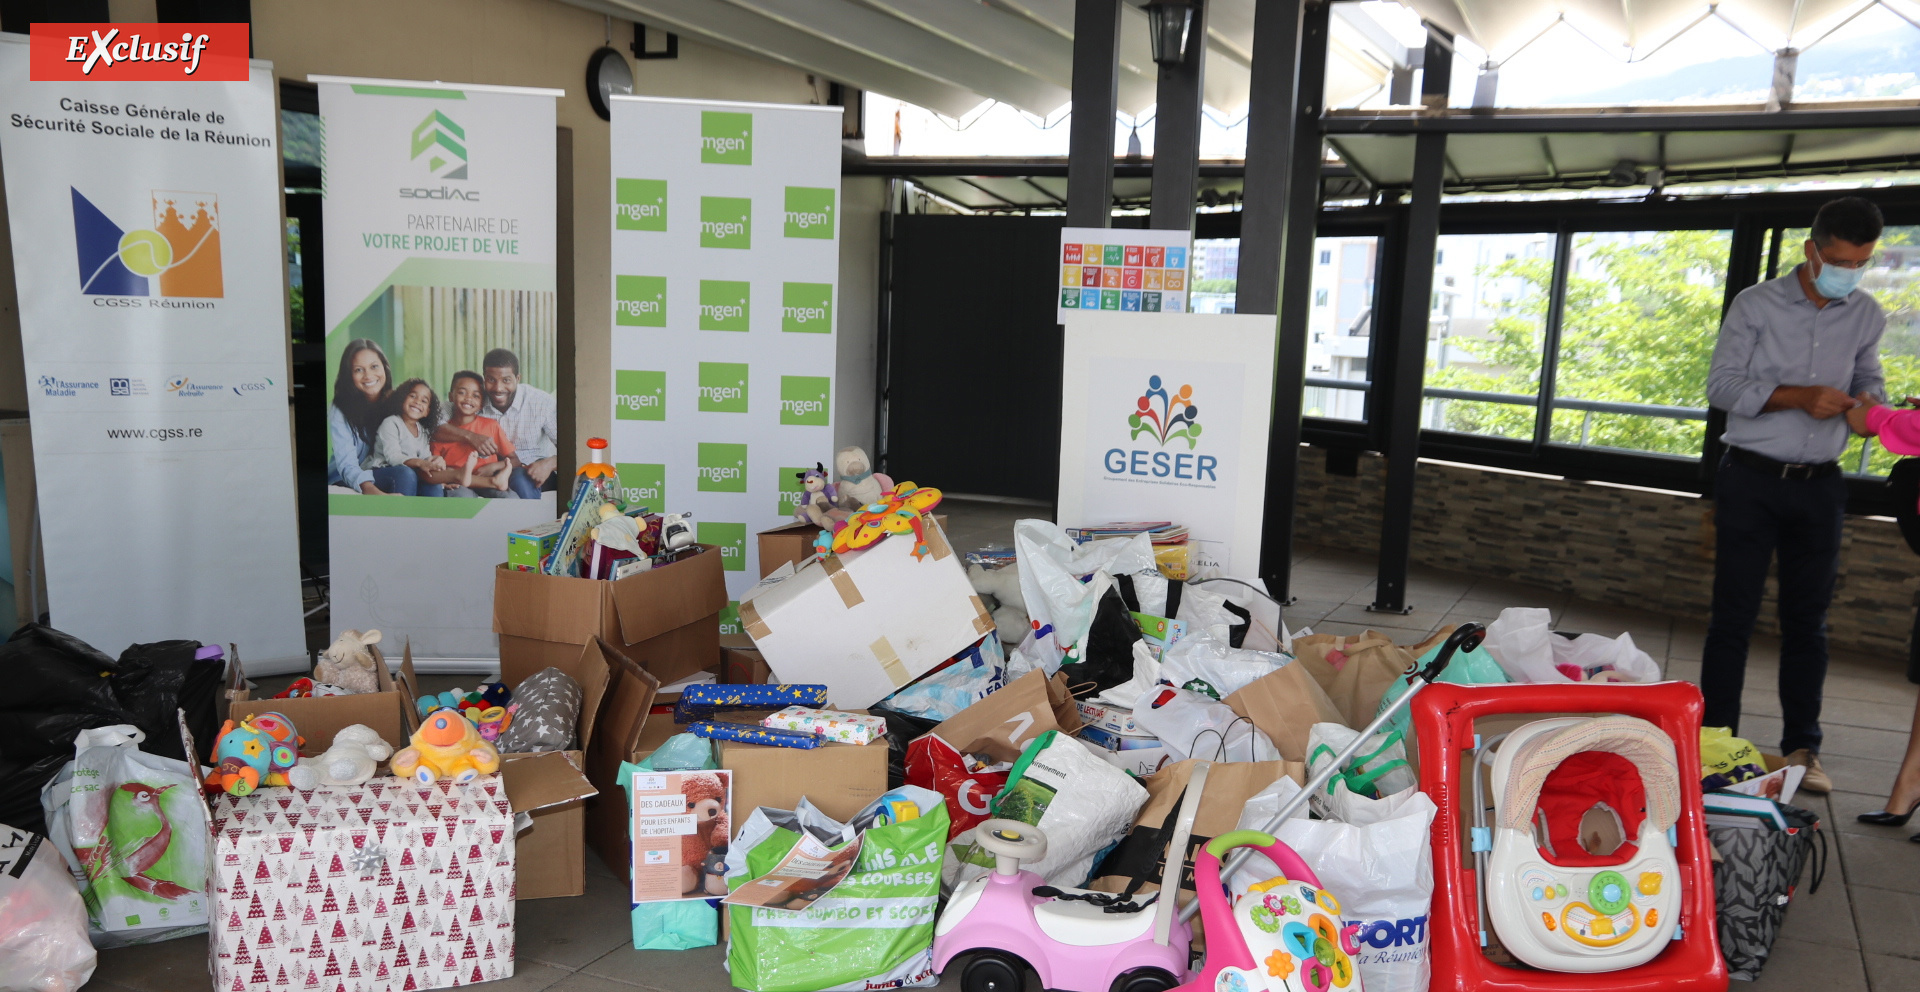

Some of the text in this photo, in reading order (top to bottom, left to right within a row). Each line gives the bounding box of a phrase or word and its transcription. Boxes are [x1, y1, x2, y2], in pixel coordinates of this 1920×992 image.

[60, 98, 225, 125] Caisse Générale de
[11, 113, 271, 148] Sécurité Sociale de la Réunion
[701, 136, 745, 154] mgen
[616, 203, 660, 220] mgen
[784, 211, 827, 228] mgen
[407, 214, 519, 235] PARTENAIRE DE
[700, 221, 744, 238] mgen
[362, 233, 519, 255] VOTRE PROJET DE VIE
[93, 298, 215, 310] CGSS Réunion
[616, 300, 659, 316] mgen
[700, 304, 742, 321] mgen
[782, 306, 825, 323] mgen
[45, 388, 76, 397] Maladie
[56, 380, 99, 389] l'Assurance
[241, 383, 266, 391] CGSS
[699, 386, 741, 402] mgen
[616, 394, 658, 411] mgen
[780, 399, 822, 415] mgen
[107, 426, 203, 441] www.cgss.re
[1104, 448, 1217, 481] GESER
[697, 466, 740, 482] mgen
[778, 490, 803, 504] mg
[720, 544, 738, 557] en
[719, 622, 737, 635] en
[72, 768, 100, 779] rotège
[1031, 759, 1067, 779] vironnement
[84, 784, 100, 792] sac
[655, 799, 684, 808] CADEAUX
[668, 816, 691, 824] ENFANTS
[862, 872, 934, 886] COURSES
[806, 906, 861, 921] JUMBO
[866, 907, 884, 920] ET
